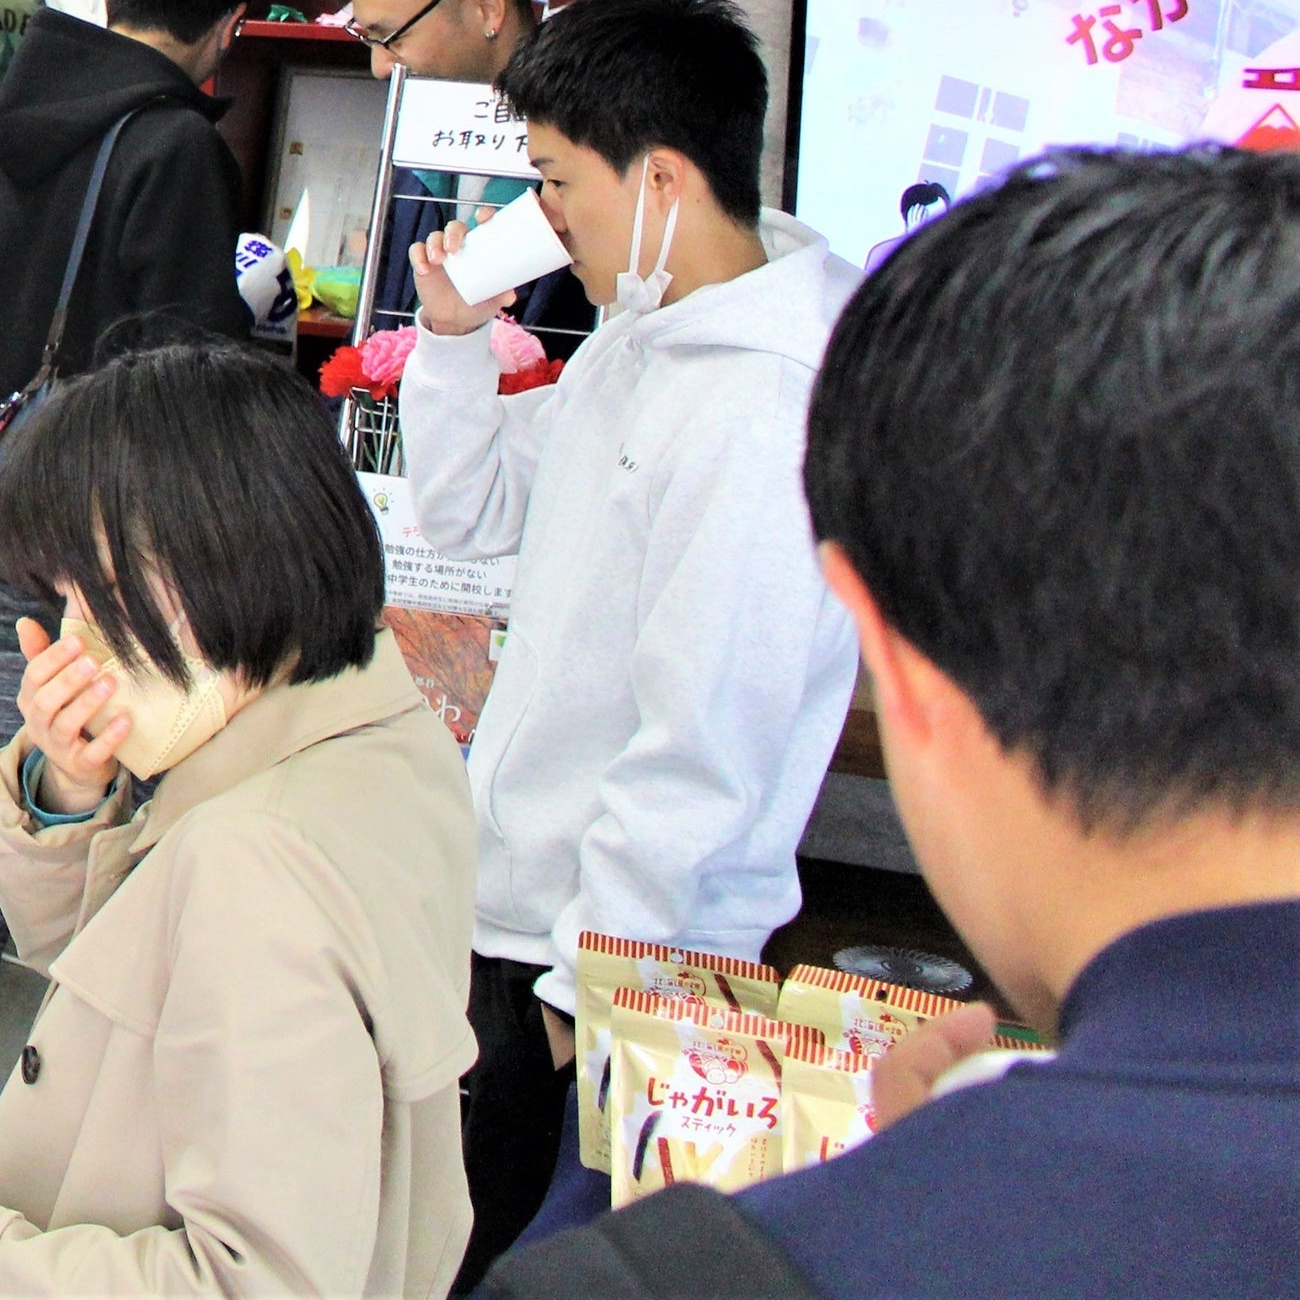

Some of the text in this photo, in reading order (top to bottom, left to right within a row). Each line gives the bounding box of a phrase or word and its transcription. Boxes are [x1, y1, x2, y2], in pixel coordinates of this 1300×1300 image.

[474, 99, 528, 123] ご自
[647, 1077, 778, 1130] じゃがいろ
[681, 1115, 737, 1137] スティック
